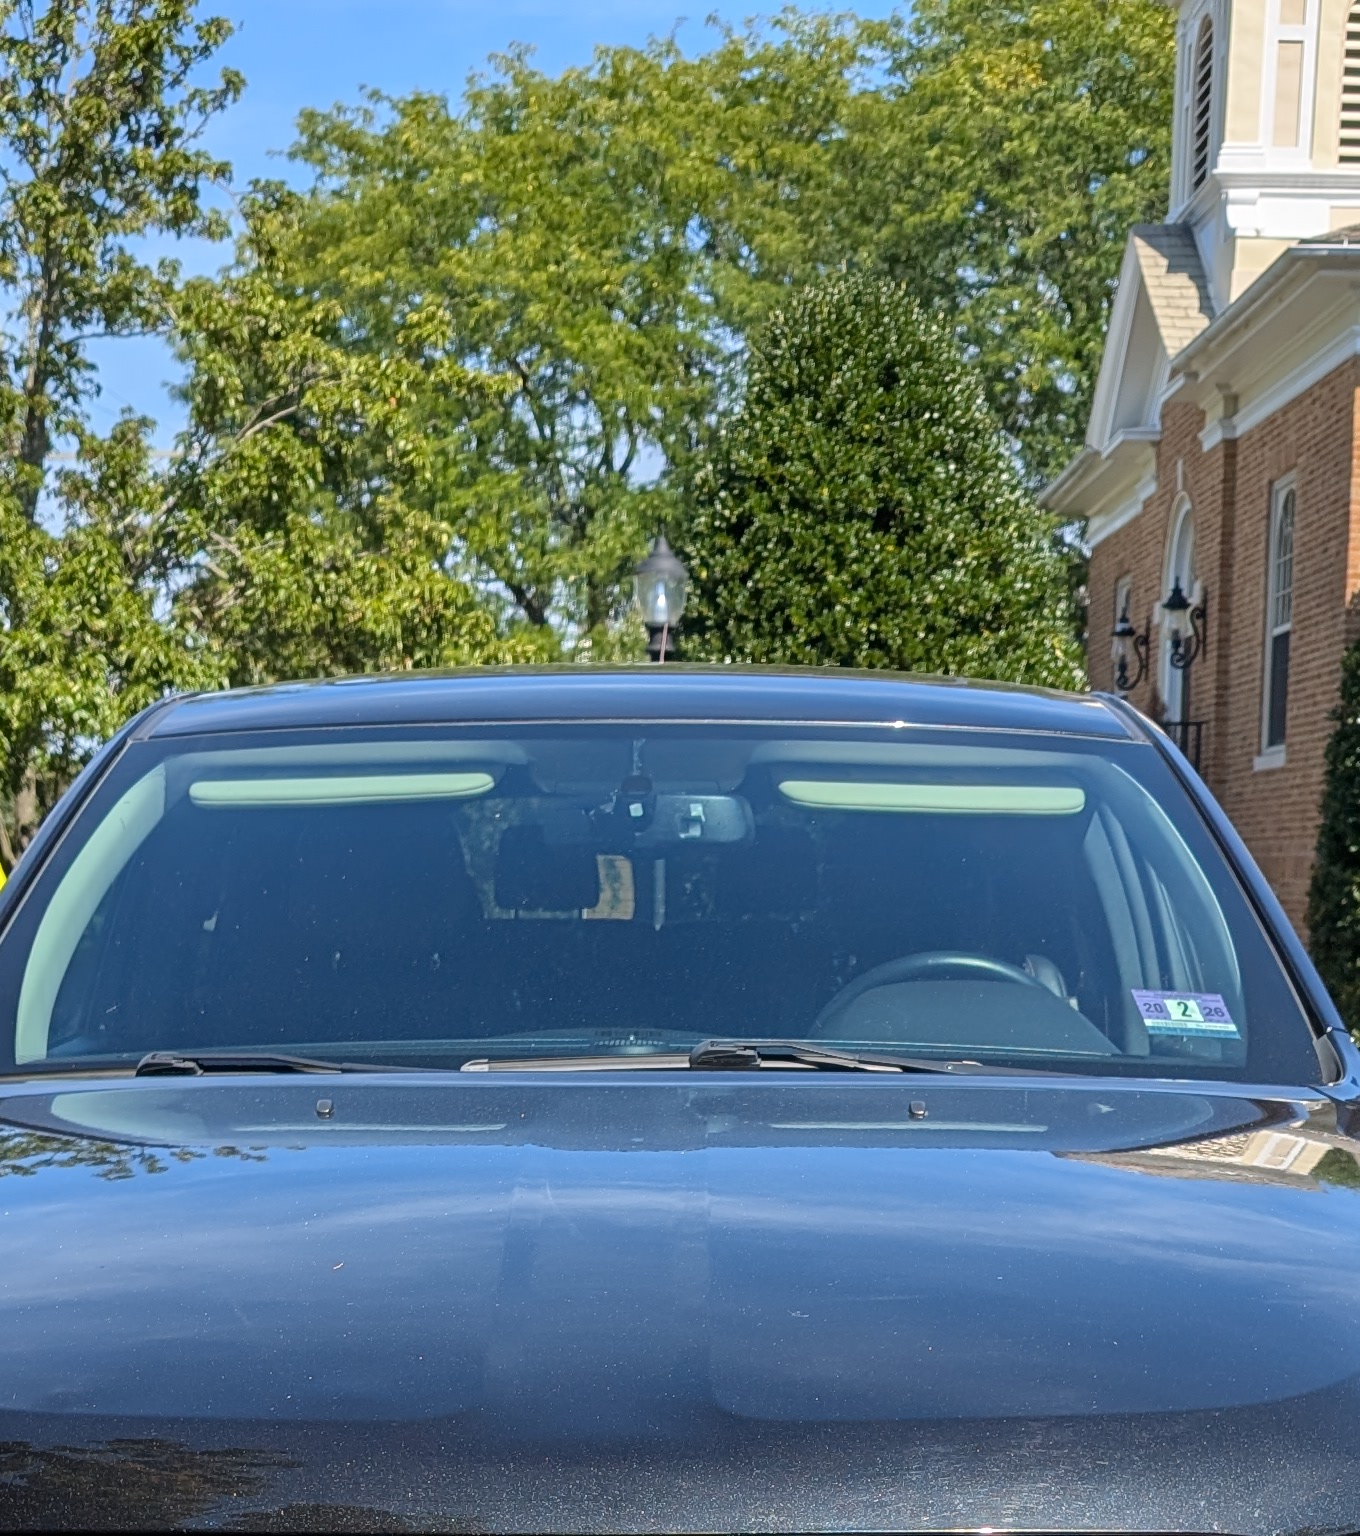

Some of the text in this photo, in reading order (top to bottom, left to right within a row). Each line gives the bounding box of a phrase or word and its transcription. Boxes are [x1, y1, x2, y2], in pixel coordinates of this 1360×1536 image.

[1143, 1001, 1225, 1018] 20 2 26
